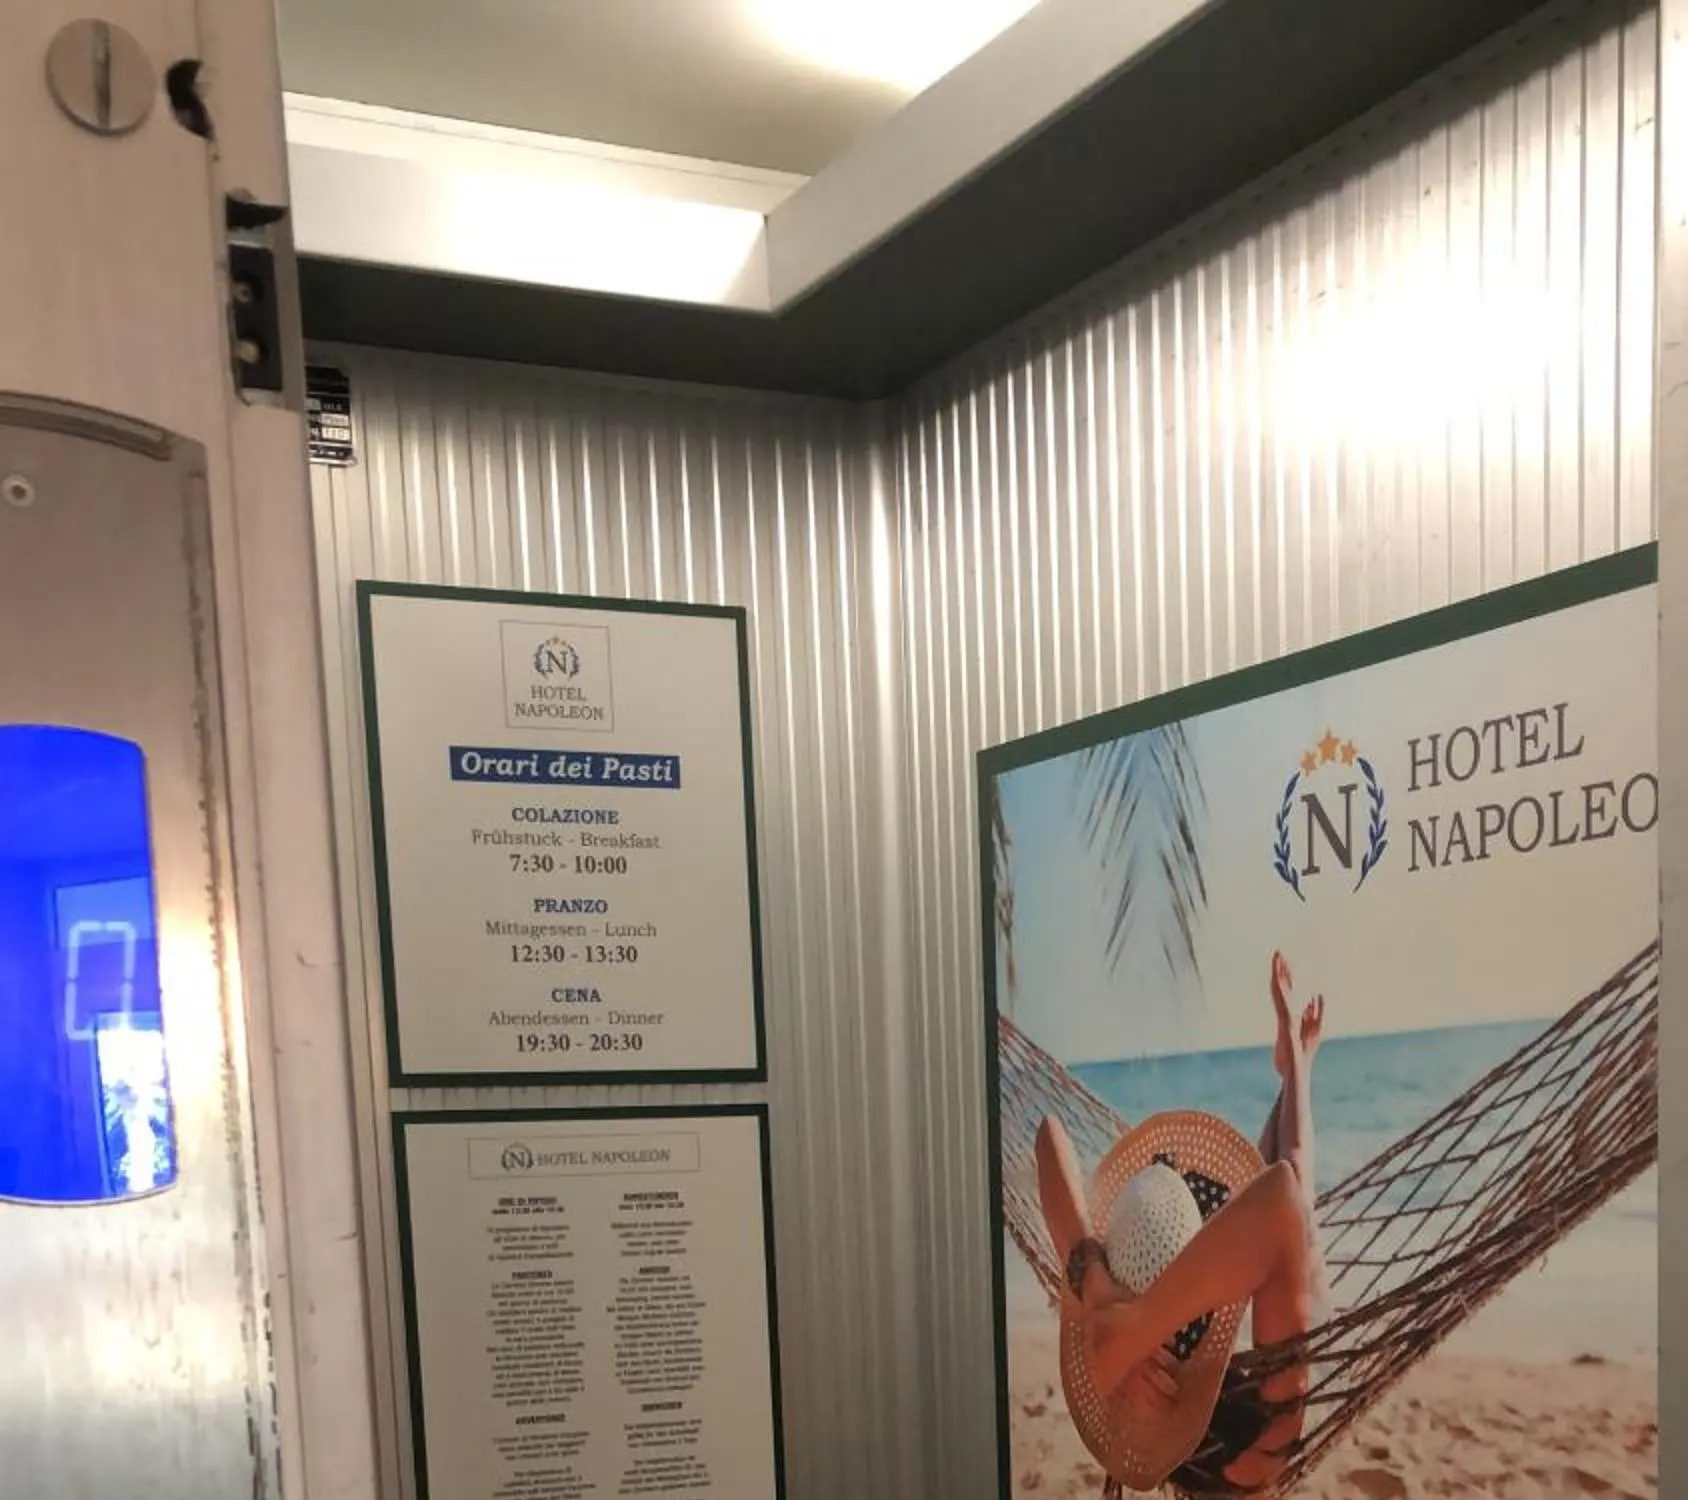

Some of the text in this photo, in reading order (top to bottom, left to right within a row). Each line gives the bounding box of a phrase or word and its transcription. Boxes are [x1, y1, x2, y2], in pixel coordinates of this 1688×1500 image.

[546, 650, 569, 675] N
[530, 685, 587, 702] HOTEL
[514, 703, 604, 721] NAPOLEON
[1408, 702, 1585, 792] HOTEL
[461, 751, 673, 782] Orari dei Pasti
[512, 807, 619, 825] COLAZIONE
[1301, 783, 1357, 877] N
[581, 831, 661, 849] Breakfast
[509, 853, 554, 873] 7:30
[575, 855, 627, 875] 10:00
[533, 899, 608, 914] PRANZO
[485, 920, 587, 940] Mittagessen
[605, 921, 657, 937] Lunch
[511, 944, 565, 963] 12:30
[585, 944, 638, 963] 13:30
[551, 988, 602, 1003] CENA
[488, 1010, 590, 1026] Abendessen
[608, 1010, 664, 1026] Dinner
[516, 1033, 571, 1053] 19:30
[589, 1033, 643, 1052] 20:30
[538, 1152, 588, 1166] HOTEL
[592, 1147, 671, 1164] NAPOLEON
